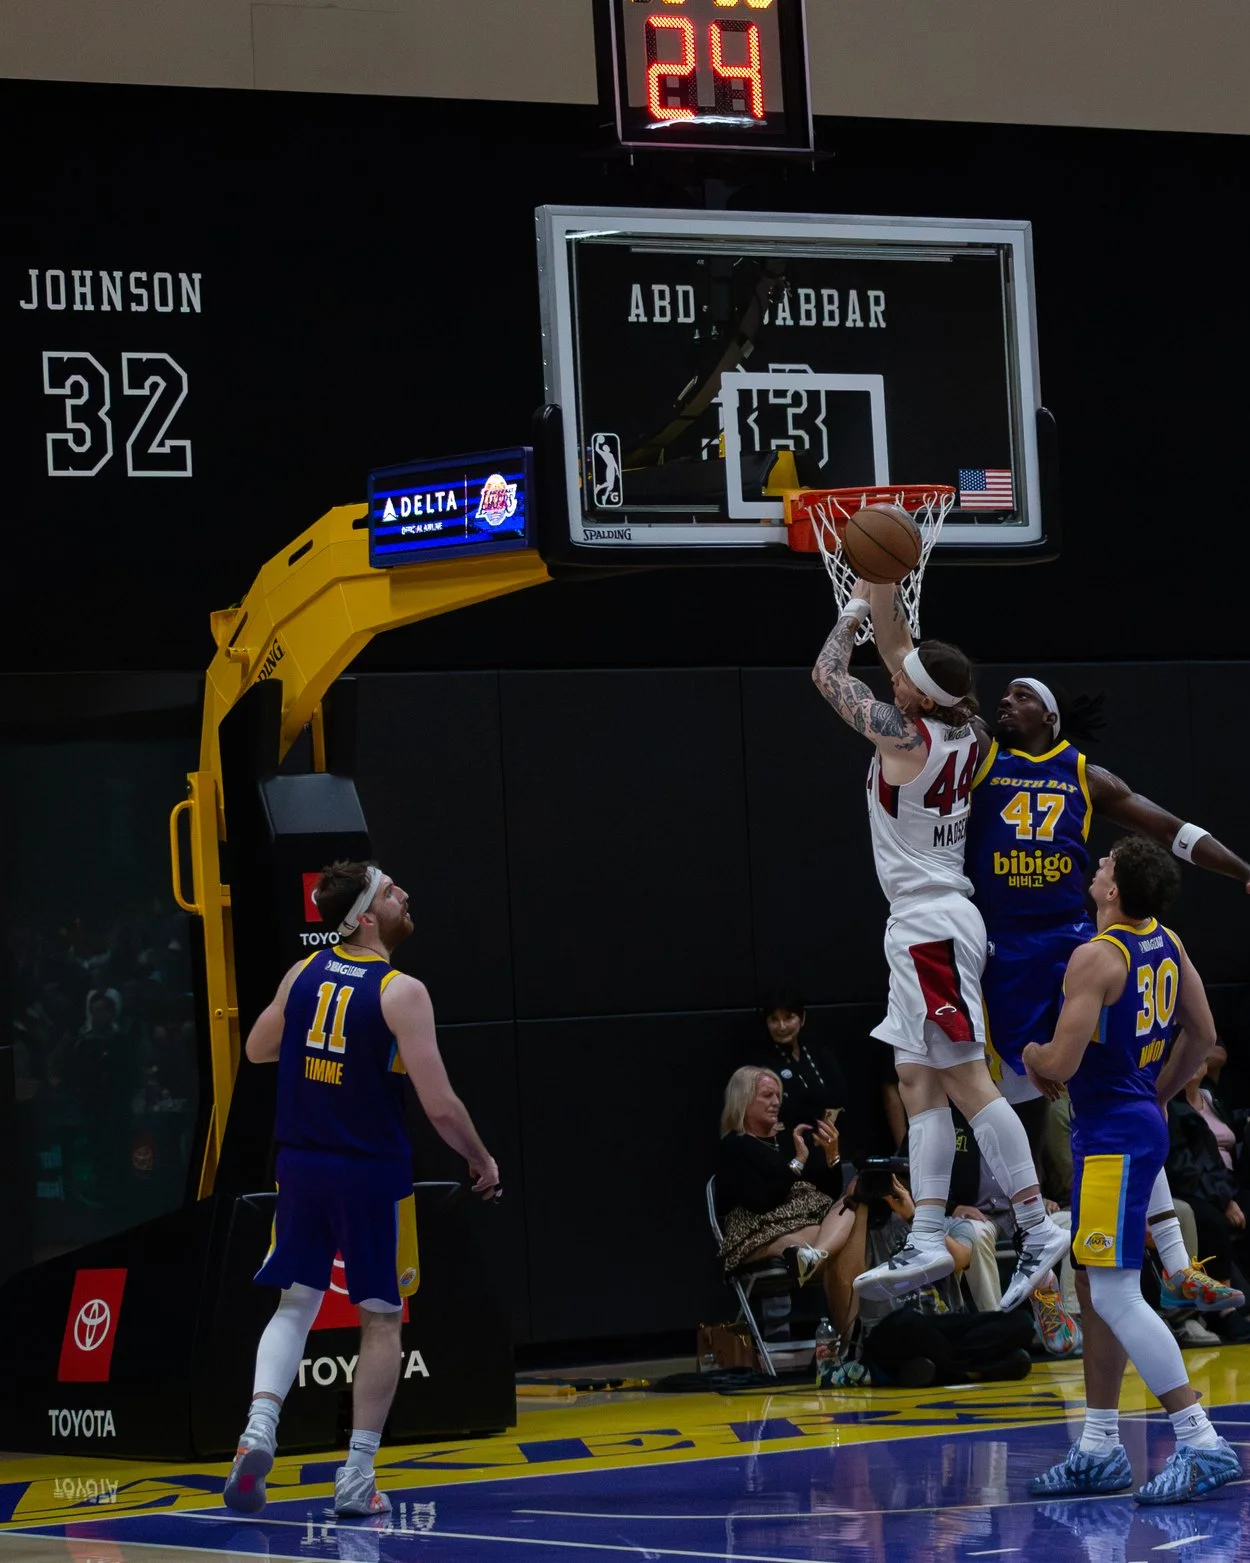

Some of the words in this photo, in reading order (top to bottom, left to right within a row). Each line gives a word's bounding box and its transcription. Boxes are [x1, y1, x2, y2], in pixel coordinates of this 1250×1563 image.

[648, 16, 764, 119] 24
[20, 269, 202, 313] JOHNSON
[628, 283, 886, 328] ABDABBAR
[42, 351, 193, 478] 32
[400, 490, 457, 518] DELTA
[610, 491, 619, 502] G
[583, 528, 632, 541] SPALDING
[989, 776, 1043, 788] SOUTH
[1044, 777, 1078, 793] BAY
[999, 791, 1066, 842] 47
[993, 850, 1073, 882] bibigo
[1008, 875, 1044, 888] 비비고
[299, 931, 342, 946] TOYO
[1136, 957, 1178, 1037] 30
[305, 981, 354, 1054] 11
[304, 1056, 344, 1086] TIMME
[299, 1350, 430, 1388] TOYA
[48, 1409, 116, 1438] TOYOTA
